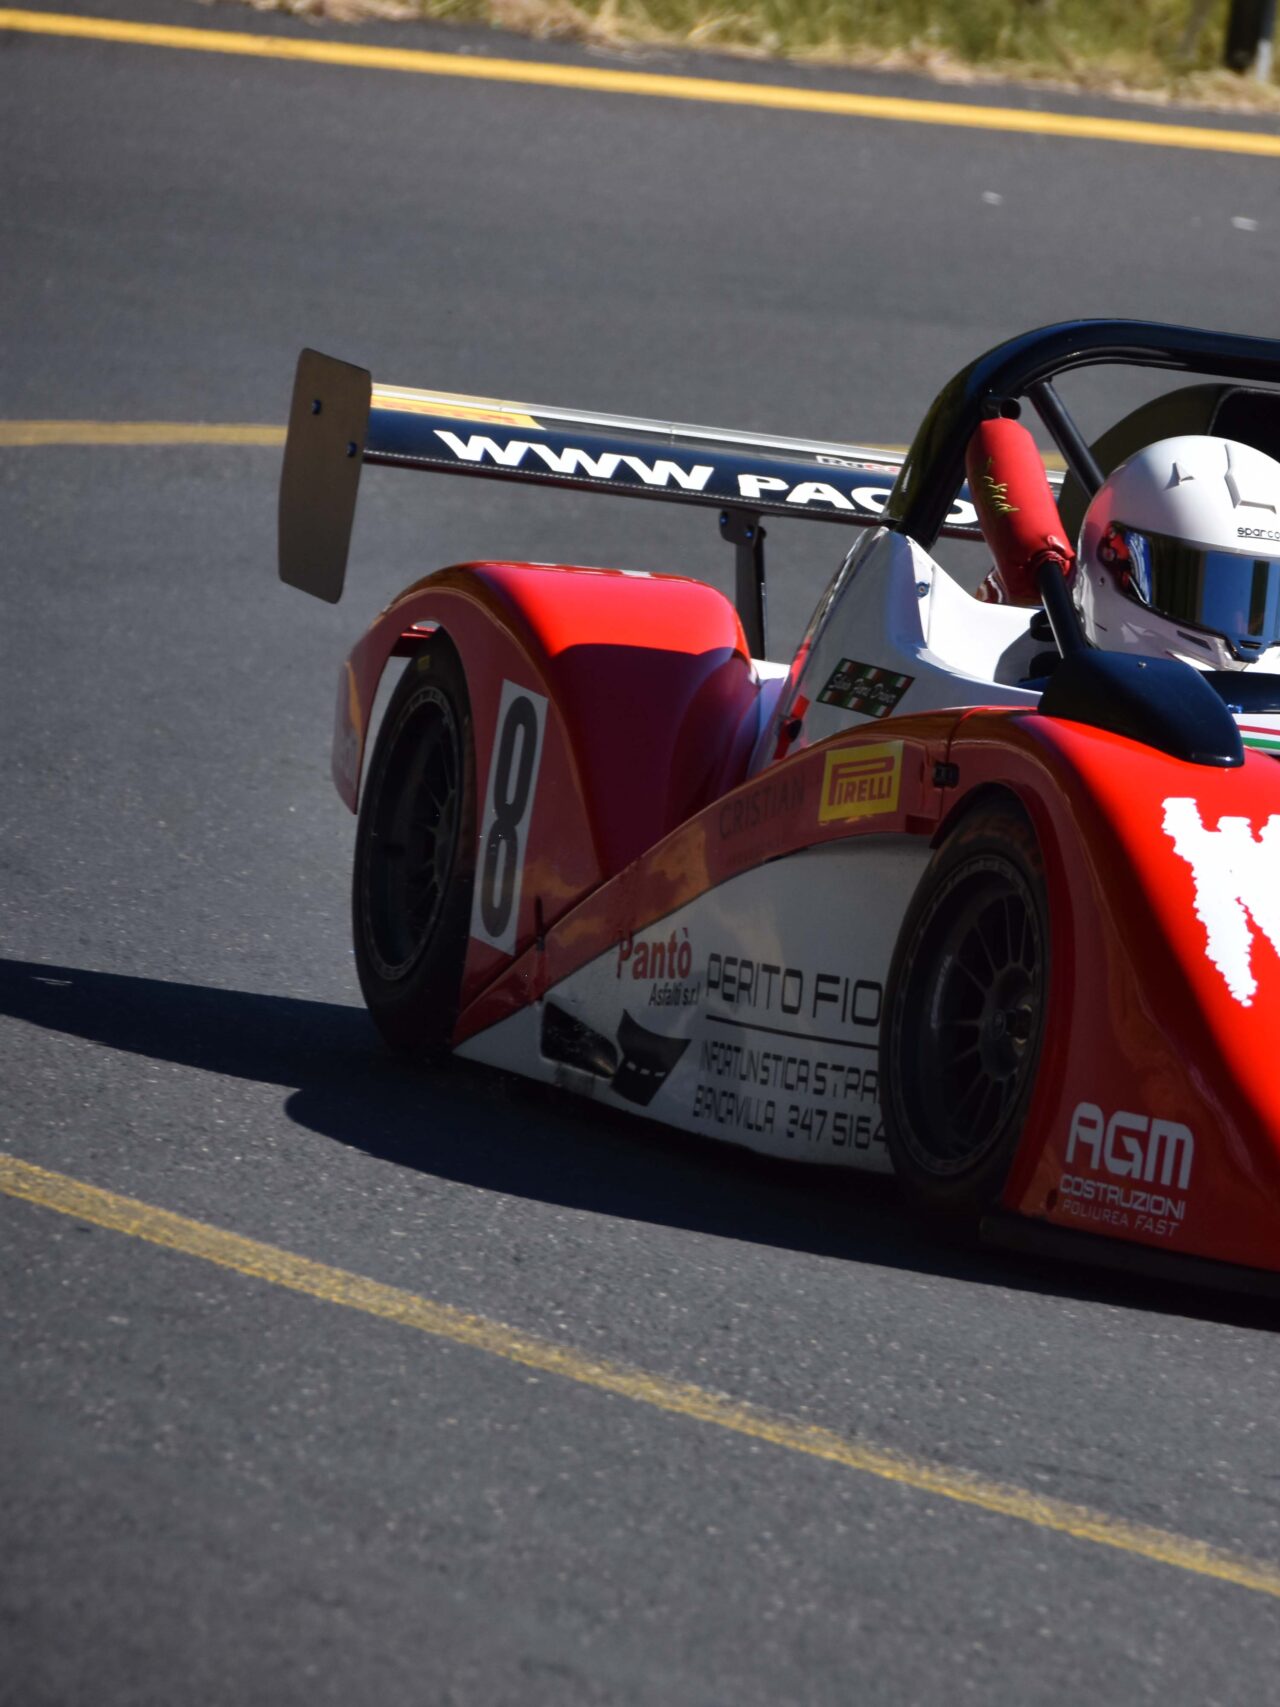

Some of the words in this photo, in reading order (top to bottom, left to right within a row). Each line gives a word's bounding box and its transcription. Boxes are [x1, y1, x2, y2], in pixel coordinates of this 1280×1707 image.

[434, 429, 713, 491] WWW
[1237, 526, 1280, 542] sparco
[719, 775, 806, 840] CRISTIAN
[828, 755, 895, 807] PIRELLI
[480, 695, 538, 939] 8
[705, 952, 803, 1015] PERITO
[785, 1103, 828, 1143] 347
[1064, 1101, 1195, 1191] AGM
[1059, 1173, 1187, 1221] COSTRUZIONI
[1134, 1213, 1181, 1238] FAST
